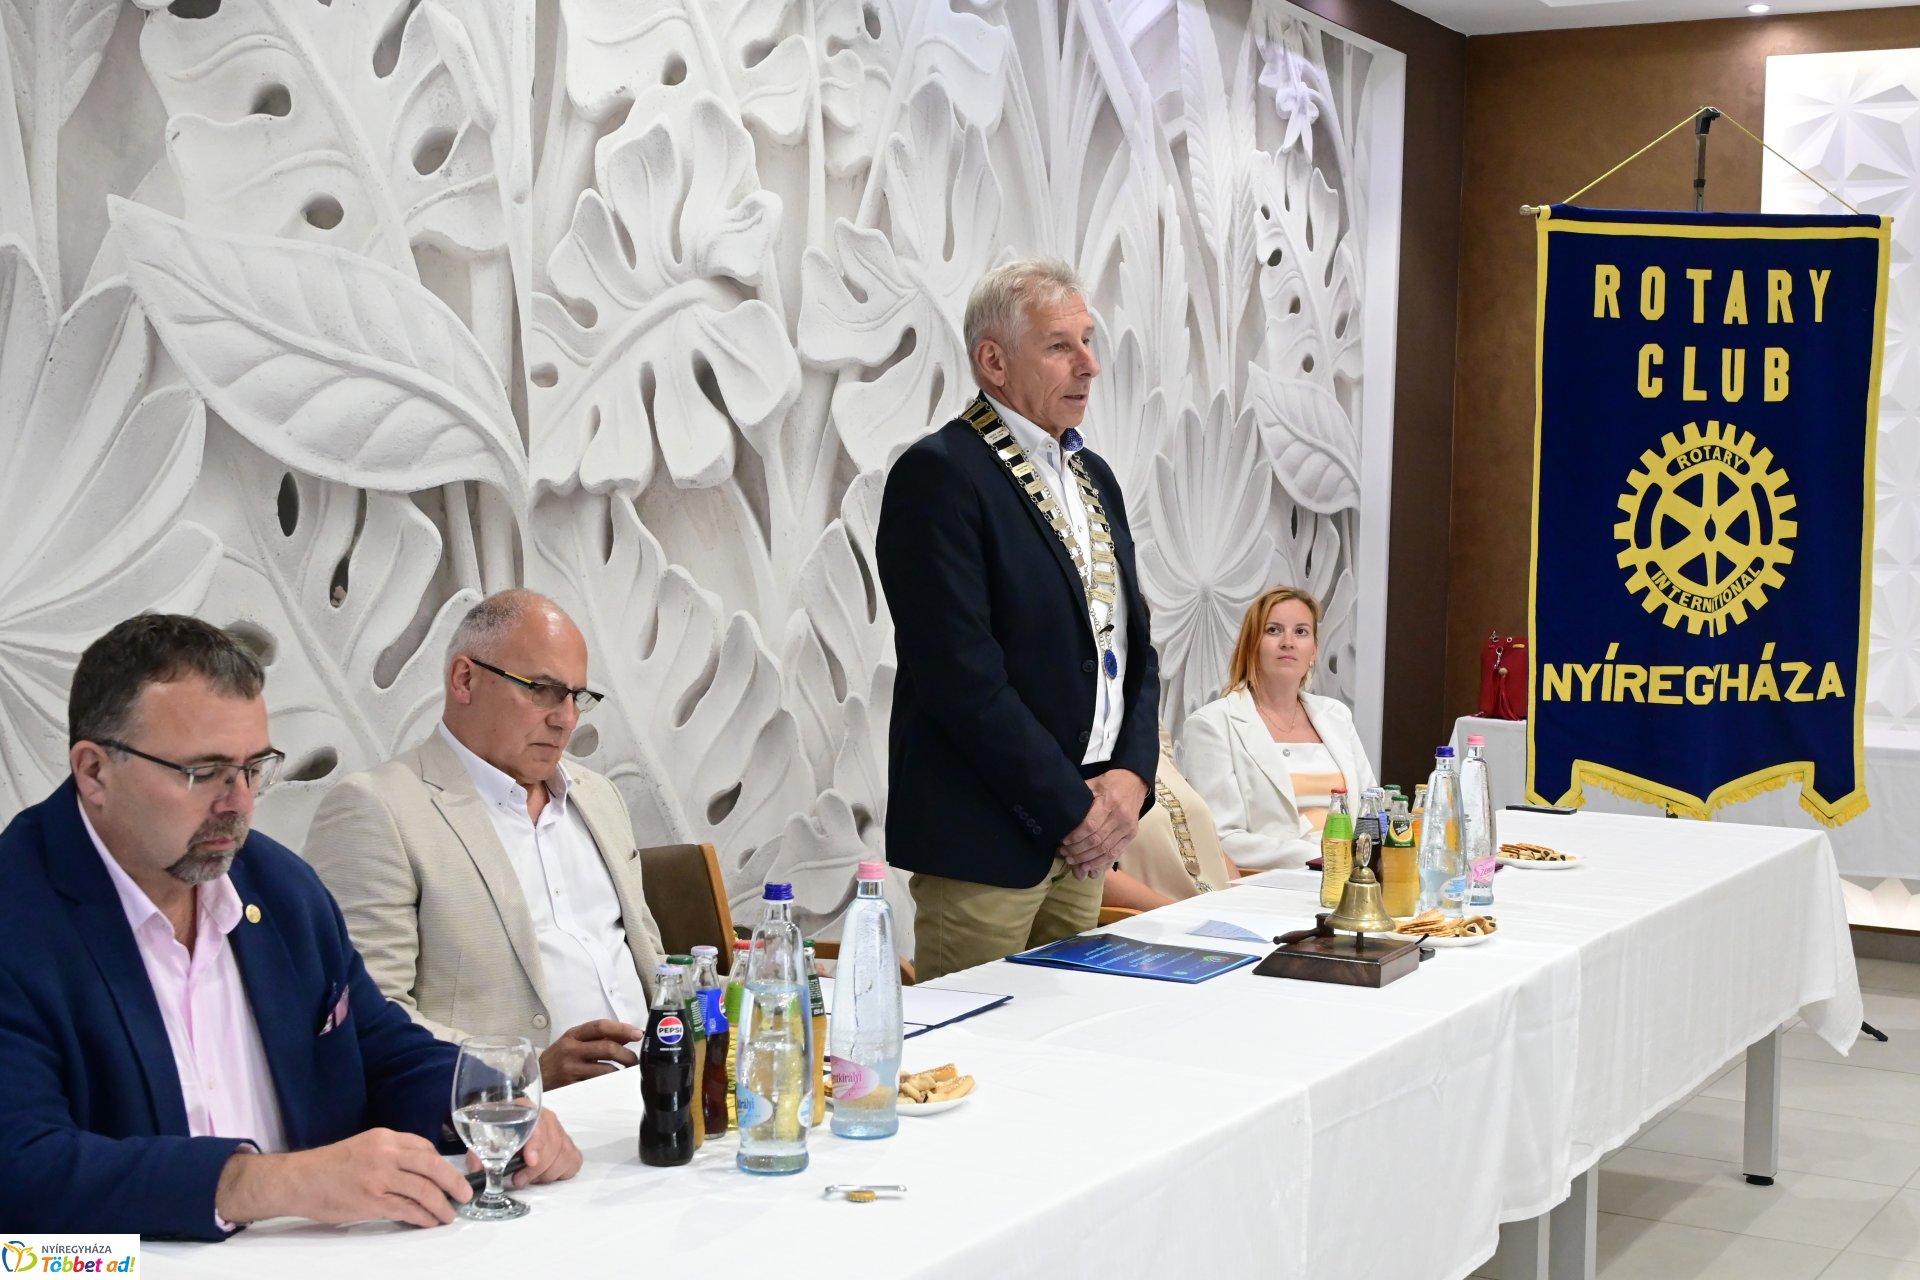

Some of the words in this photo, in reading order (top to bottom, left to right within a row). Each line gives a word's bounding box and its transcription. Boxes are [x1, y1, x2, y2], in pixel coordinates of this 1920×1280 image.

[1594, 264, 1832, 325] ROTARY
[1637, 343, 1790, 402] CLUB
[1676, 446, 1744, 470] ROTARY
[1651, 566, 1761, 613] INTERNTIONAL
